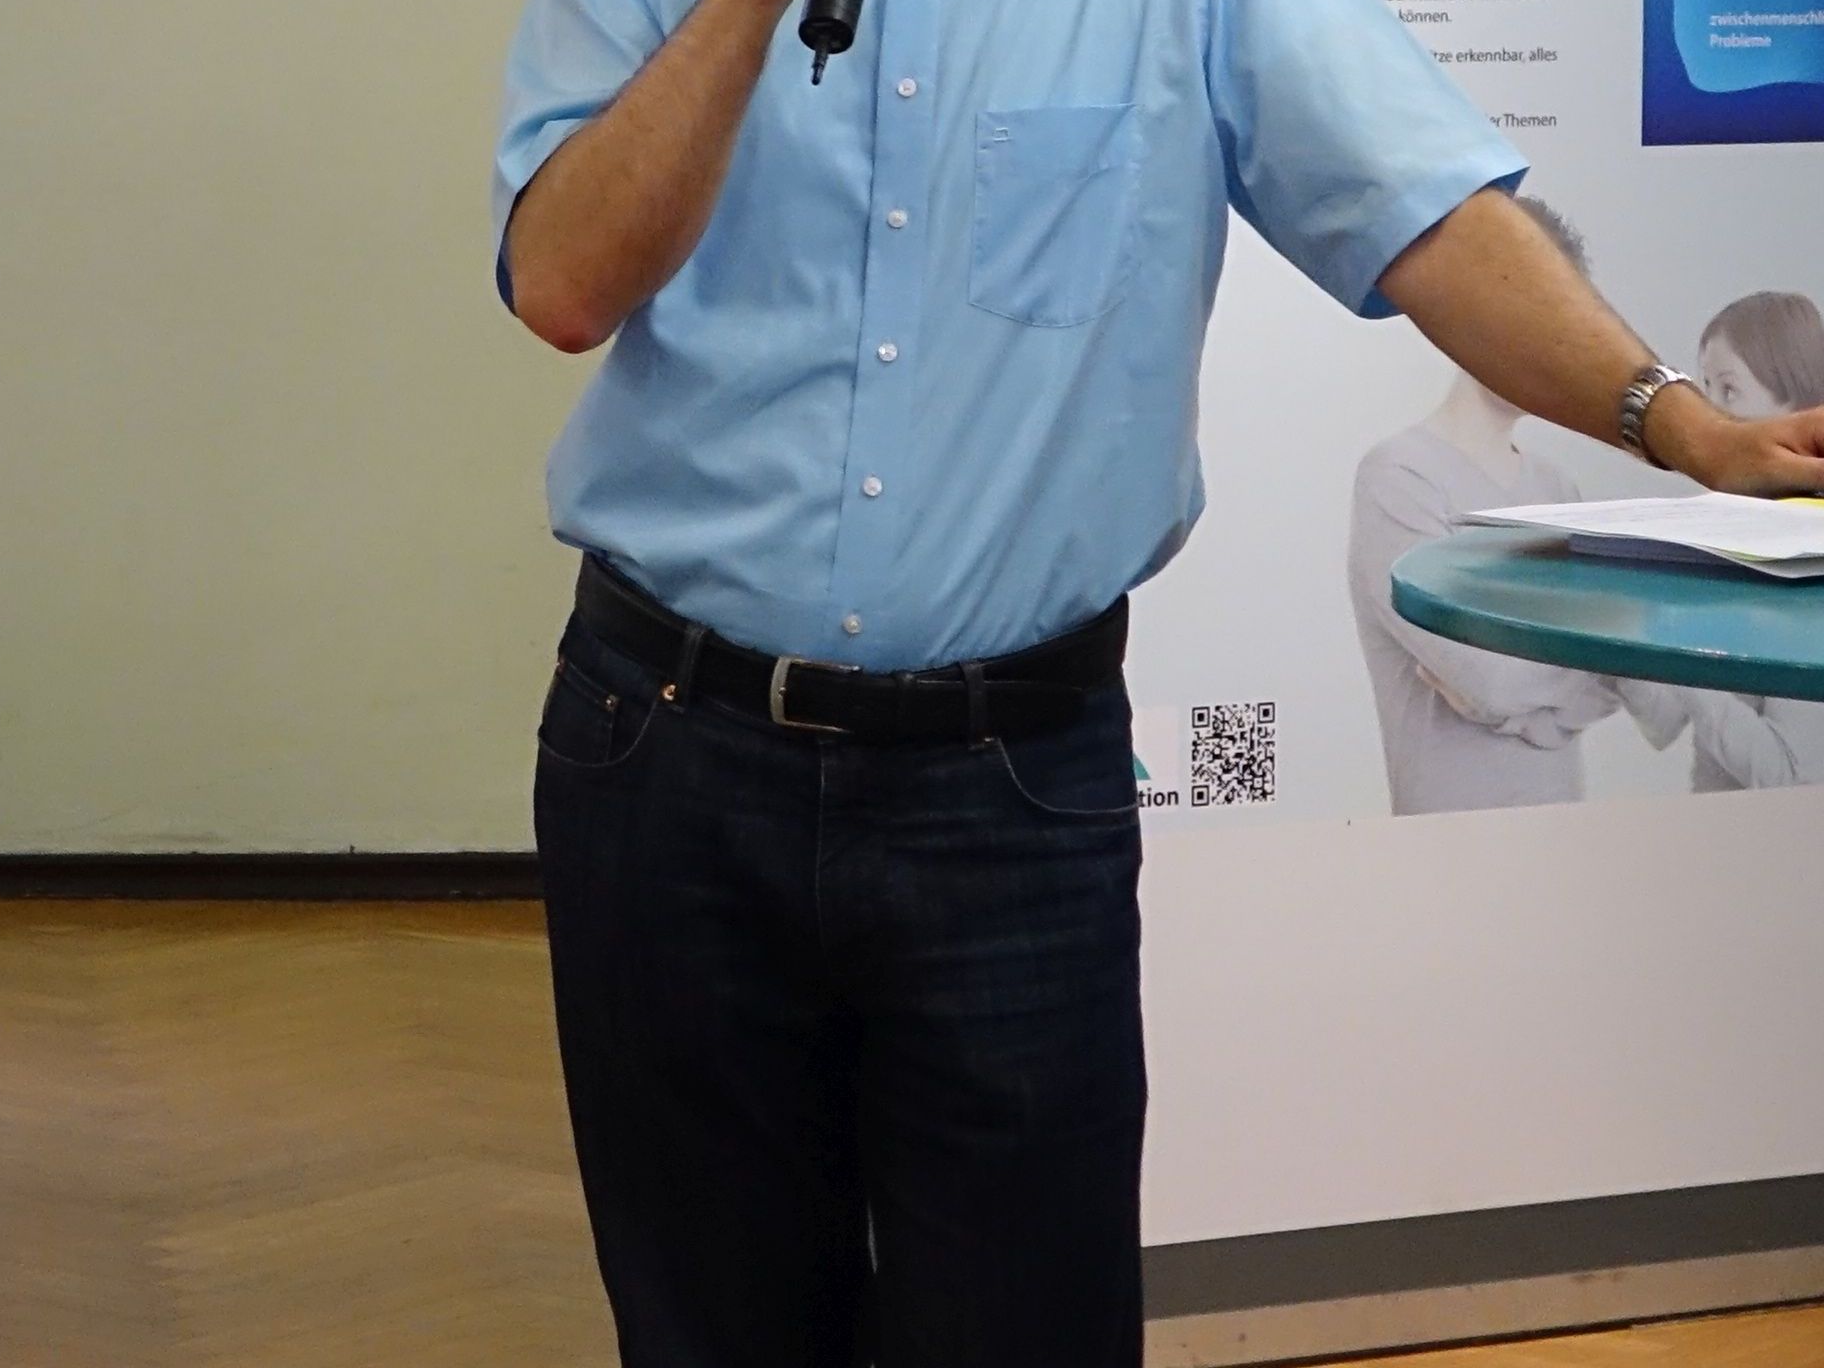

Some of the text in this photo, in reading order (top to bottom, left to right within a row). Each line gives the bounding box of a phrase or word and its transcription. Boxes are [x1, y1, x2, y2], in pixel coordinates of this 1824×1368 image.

[1399, 9, 1452, 22] können.
[1710, 33, 1772, 48] Probleme
[1456, 48, 1524, 63] erkennbar,
[1529, 47, 1557, 61] alles
[1503, 114, 1557, 127] Themen
